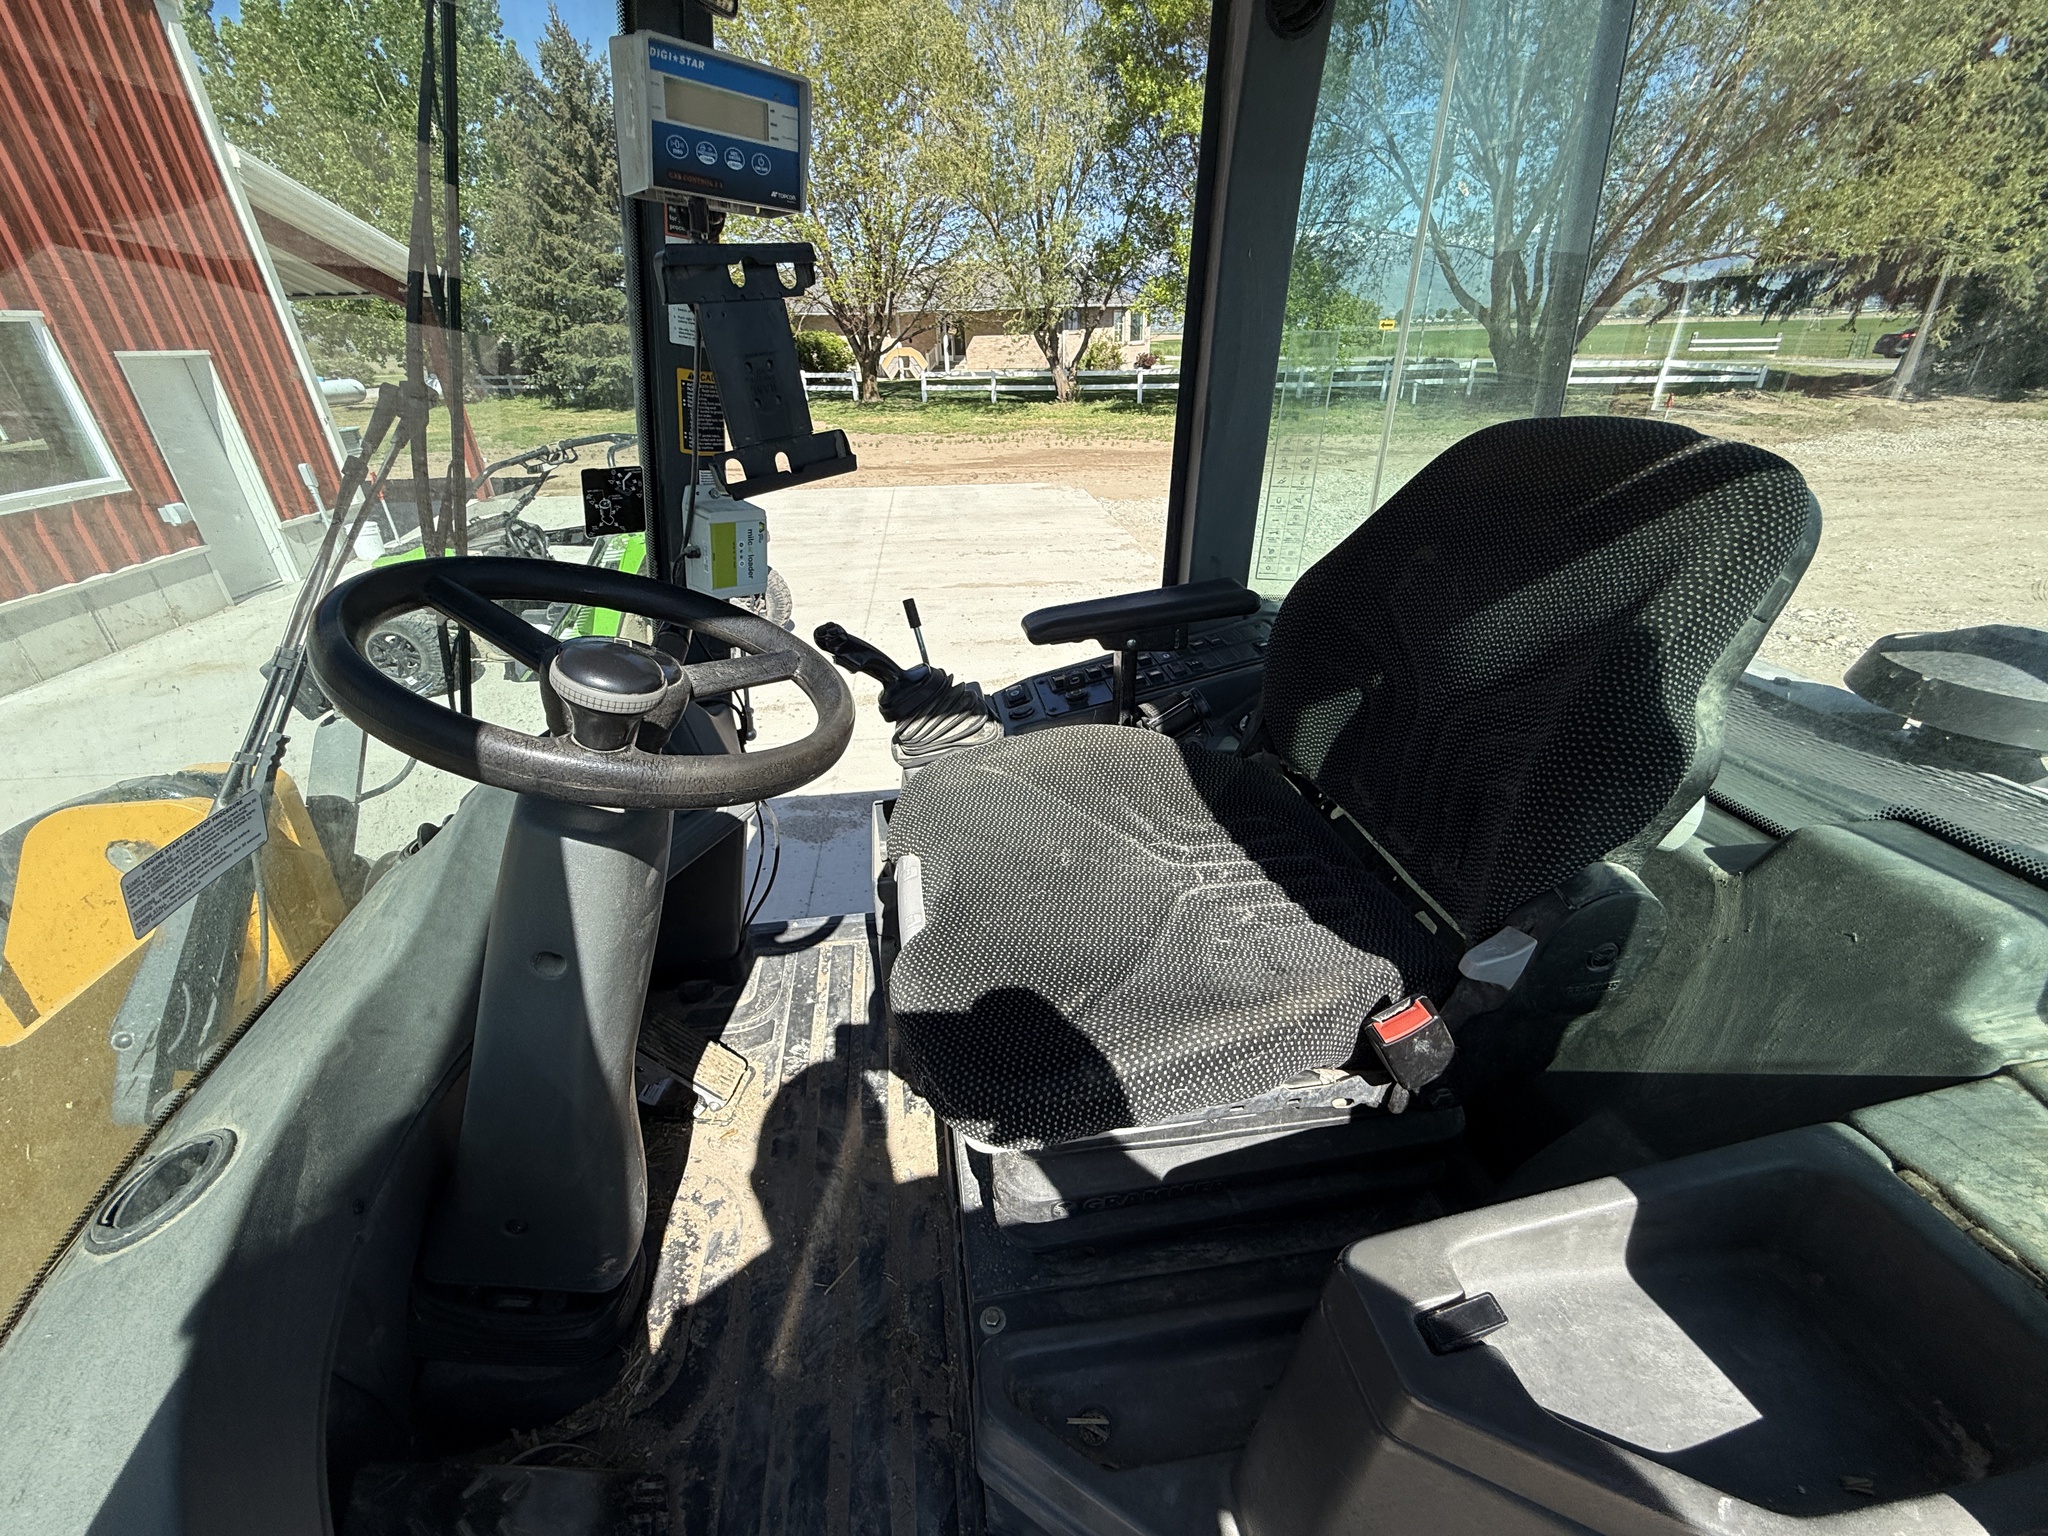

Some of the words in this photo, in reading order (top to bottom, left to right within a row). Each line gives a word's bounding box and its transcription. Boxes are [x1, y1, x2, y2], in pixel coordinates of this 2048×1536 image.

[747, 554, 755, 580] loader
[142, 852, 164, 871] ENGINE
[165, 839, 183, 855] START
[184, 830, 196, 842] AND
[197, 820, 211, 833] STOP
[212, 798, 243, 824] PROCEDURE
[1082, 1179, 1228, 1211] GRAMMER
